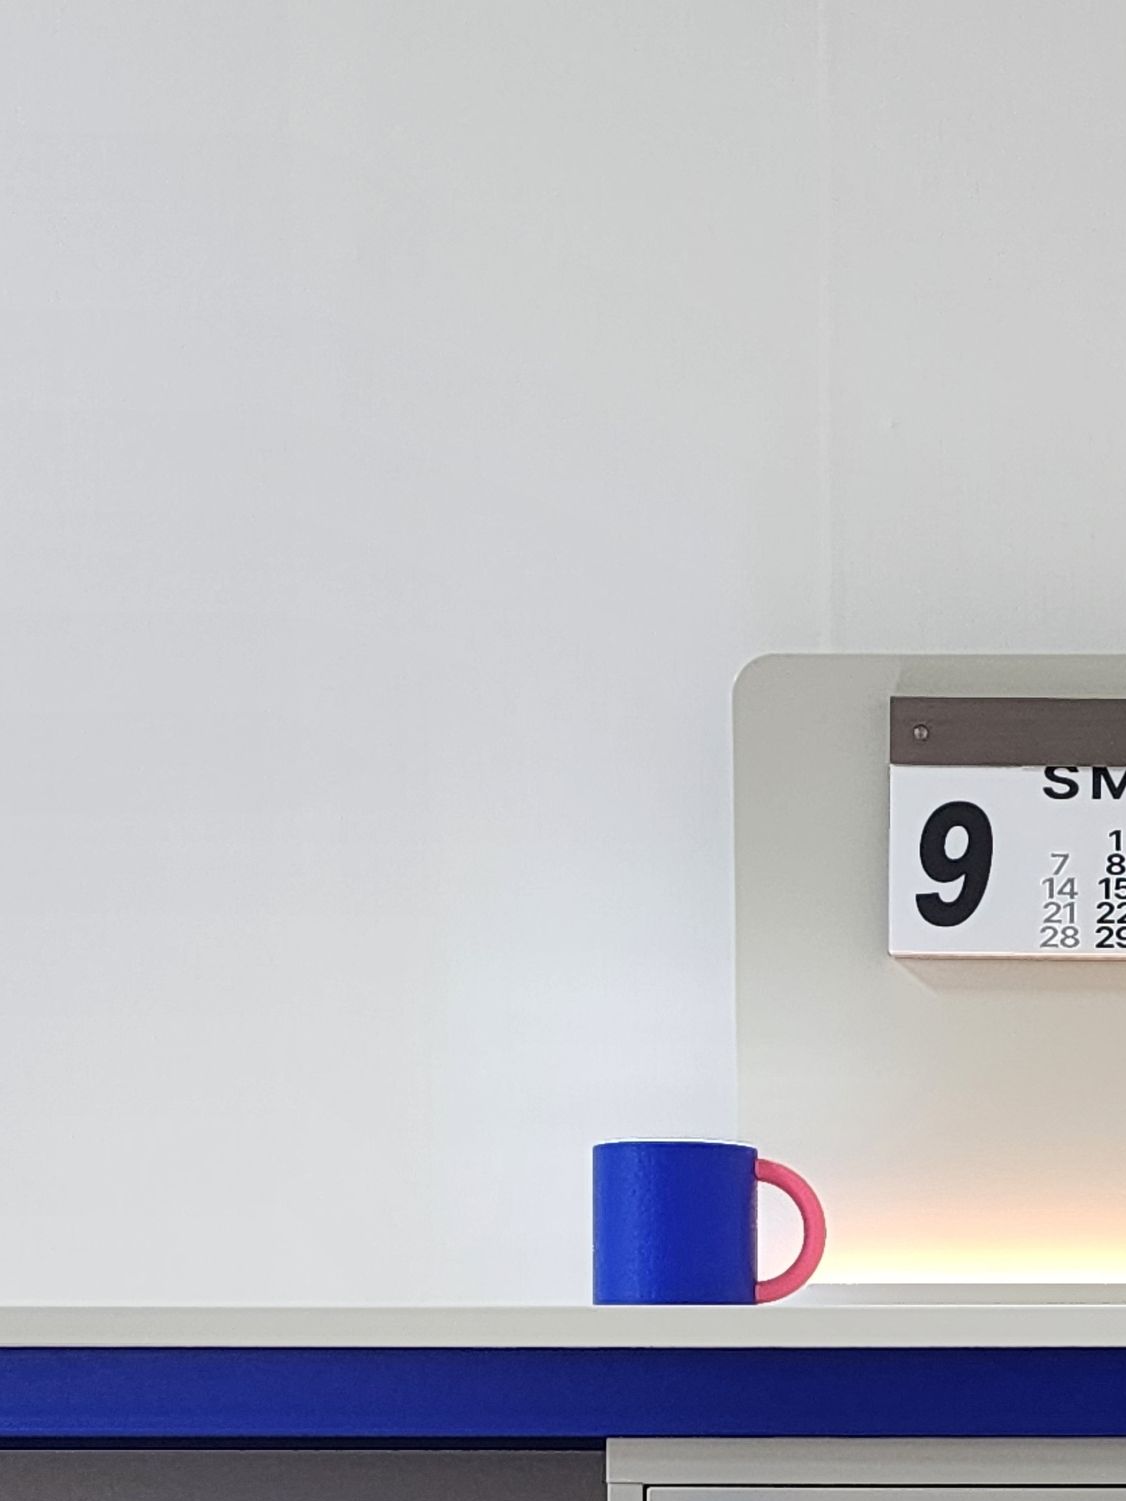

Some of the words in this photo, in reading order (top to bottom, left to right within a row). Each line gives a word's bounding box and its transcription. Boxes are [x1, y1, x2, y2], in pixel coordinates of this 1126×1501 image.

[1042, 767, 1079, 799] S
[1109, 830, 1121, 851] 1
[916, 800, 993, 928] 9
[1050, 853, 1069, 875] 7
[1106, 853, 1126, 875] 8
[1042, 877, 1078, 899] 14
[1042, 902, 1076, 924] 21
[1040, 926, 1080, 948] 28
